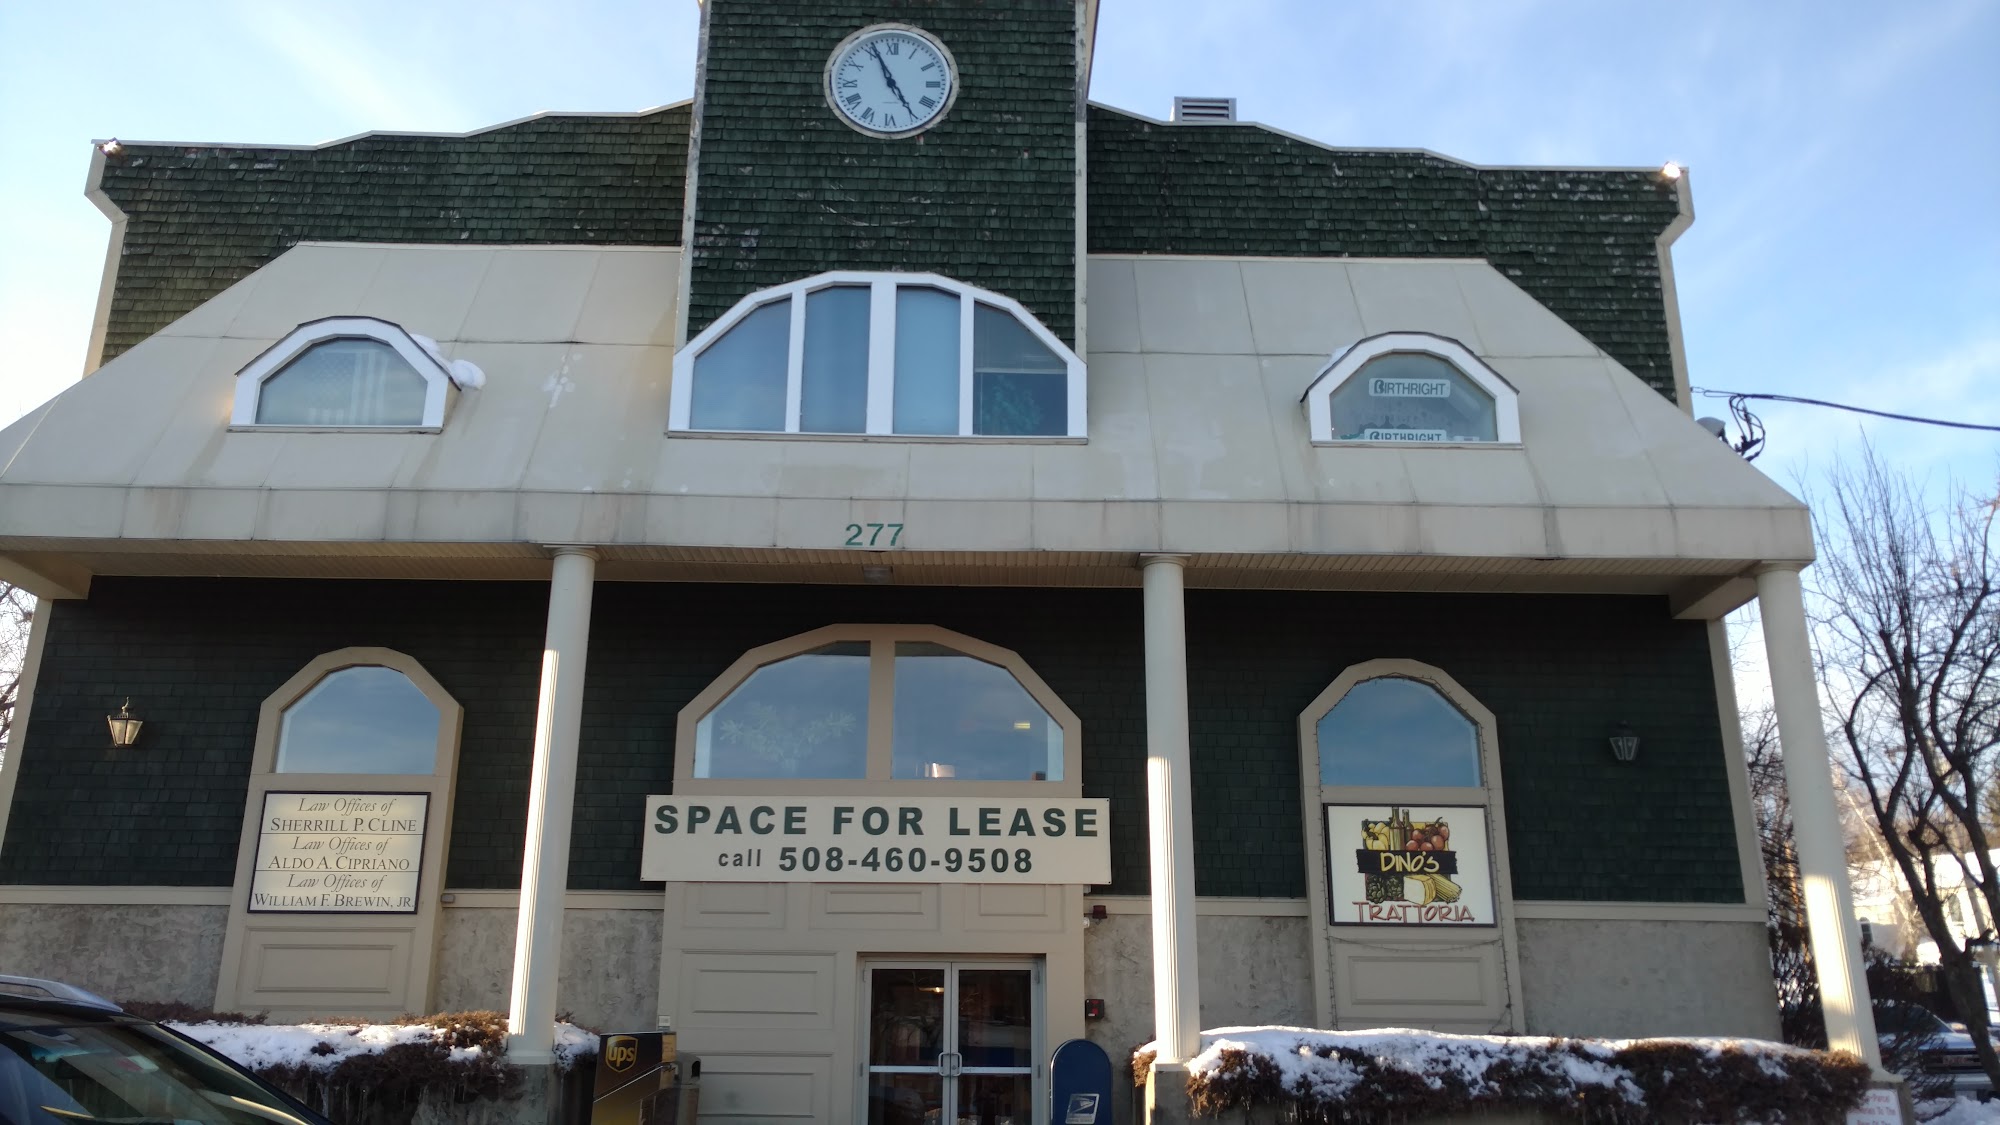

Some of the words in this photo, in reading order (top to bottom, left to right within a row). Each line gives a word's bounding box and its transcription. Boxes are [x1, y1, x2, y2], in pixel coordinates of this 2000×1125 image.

[1373, 379, 1446, 396] BIRTHRIGHT
[845, 523, 904, 546] 277
[297, 798, 330, 812] Law
[334, 798, 376, 816] Offices
[380, 798, 397, 816] of
[270, 817, 349, 832] SHERRILL
[353, 818, 364, 832] P.
[368, 818, 417, 832] CLINE
[654, 804, 807, 835] SPACE
[833, 806, 924, 836] FOR
[949, 807, 1098, 837] LEASE
[292, 836, 325, 850] Law
[329, 836, 371, 855] Offices
[375, 837, 392, 855] of
[268, 855, 314, 869] ALDO
[317, 856, 332, 870] A.
[335, 855, 410, 870] CIPRIANO
[718, 848, 762, 867] call
[778, 846, 1032, 873] 508-460-9508
[1380, 851, 1440, 873] DINO'S
[286, 873, 319, 888] Law
[323, 874, 367, 893] Offices
[371, 874, 388, 893] of
[254, 893, 317, 907] WILLIAM
[320, 893, 330, 907] F.
[333, 893, 393, 908] BREWIN,
[396, 896, 415, 908] JR.
[1352, 901, 1475, 924] TRATTORIA
[608, 1046, 635, 1067] ups
